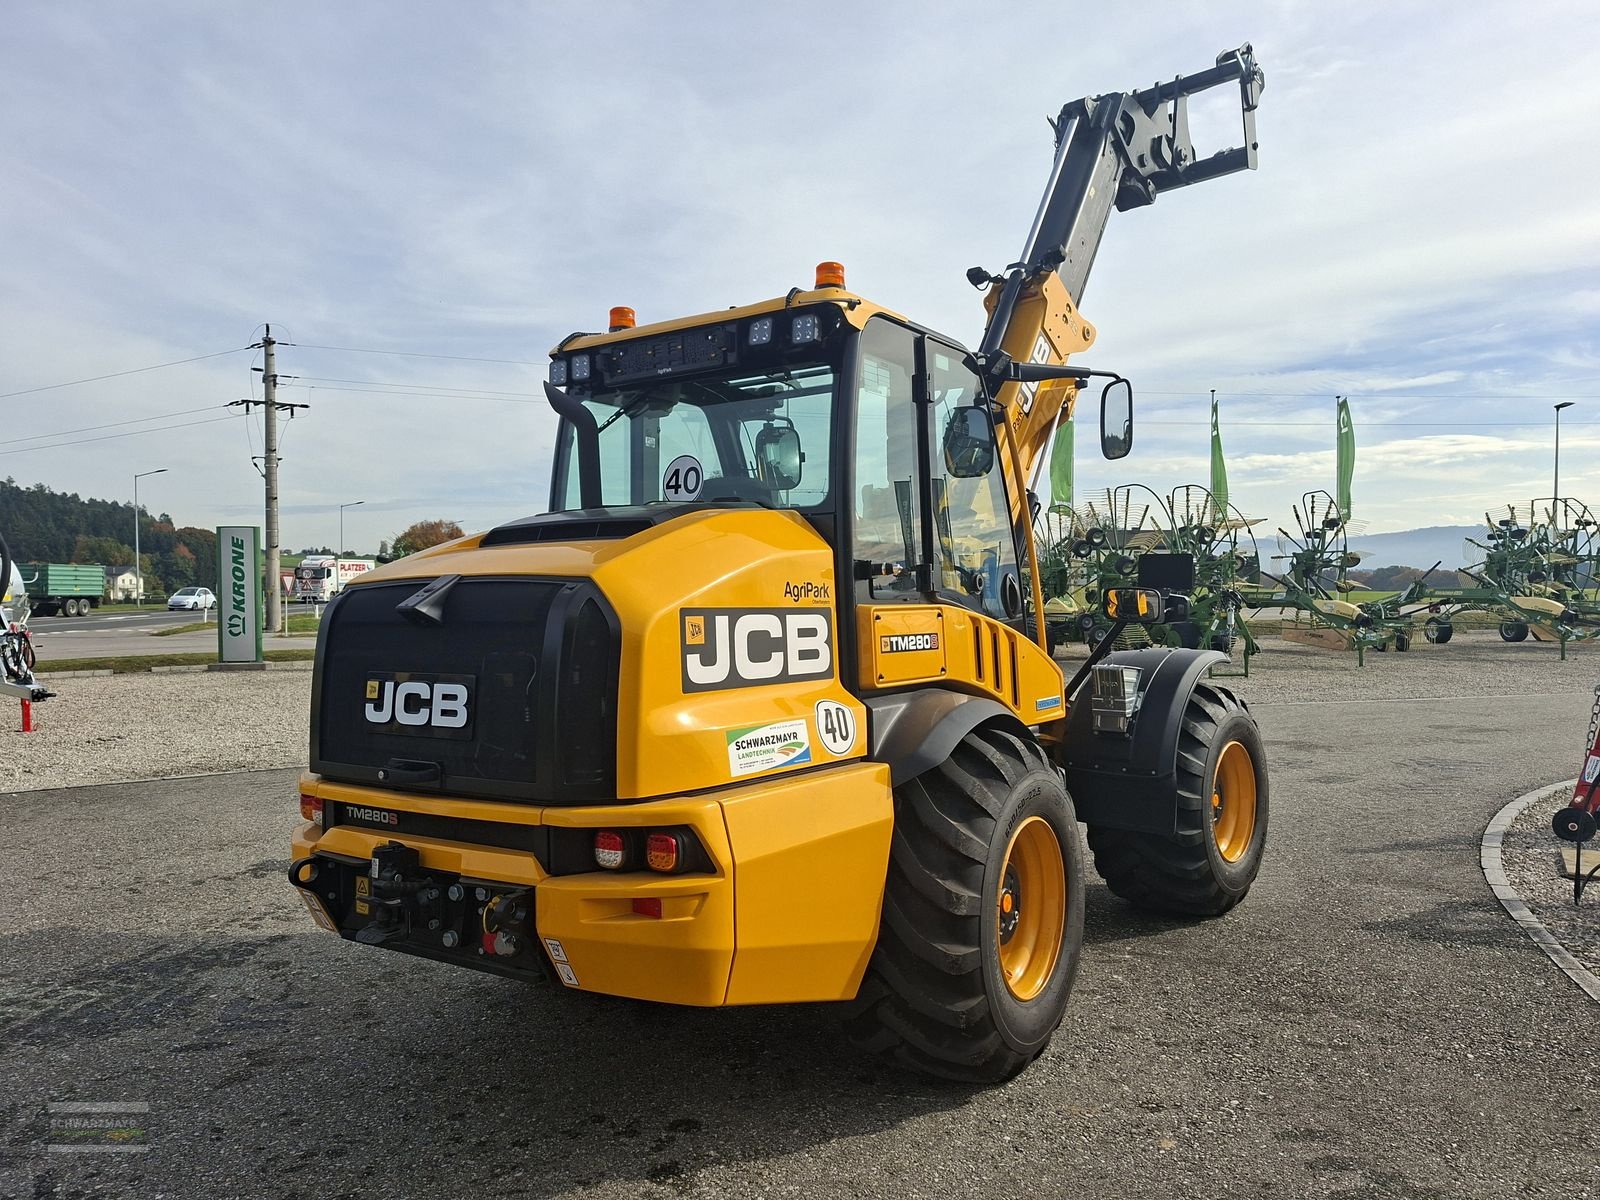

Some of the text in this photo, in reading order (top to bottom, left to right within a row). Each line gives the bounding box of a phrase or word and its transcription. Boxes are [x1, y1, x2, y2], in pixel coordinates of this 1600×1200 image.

[665, 466, 700, 495] 40
[231, 535, 246, 613] KRONE
[784, 581, 830, 602] AgriPark
[686, 614, 831, 685] JCB
[890, 634, 938, 651] TM280S
[365, 680, 468, 728] JCB
[824, 707, 850, 744] 40
[735, 731, 798, 751] SCHWARZMAYR
[738, 748, 776, 760] LANDTECHNIK
[346, 806, 398, 825] TM280S
